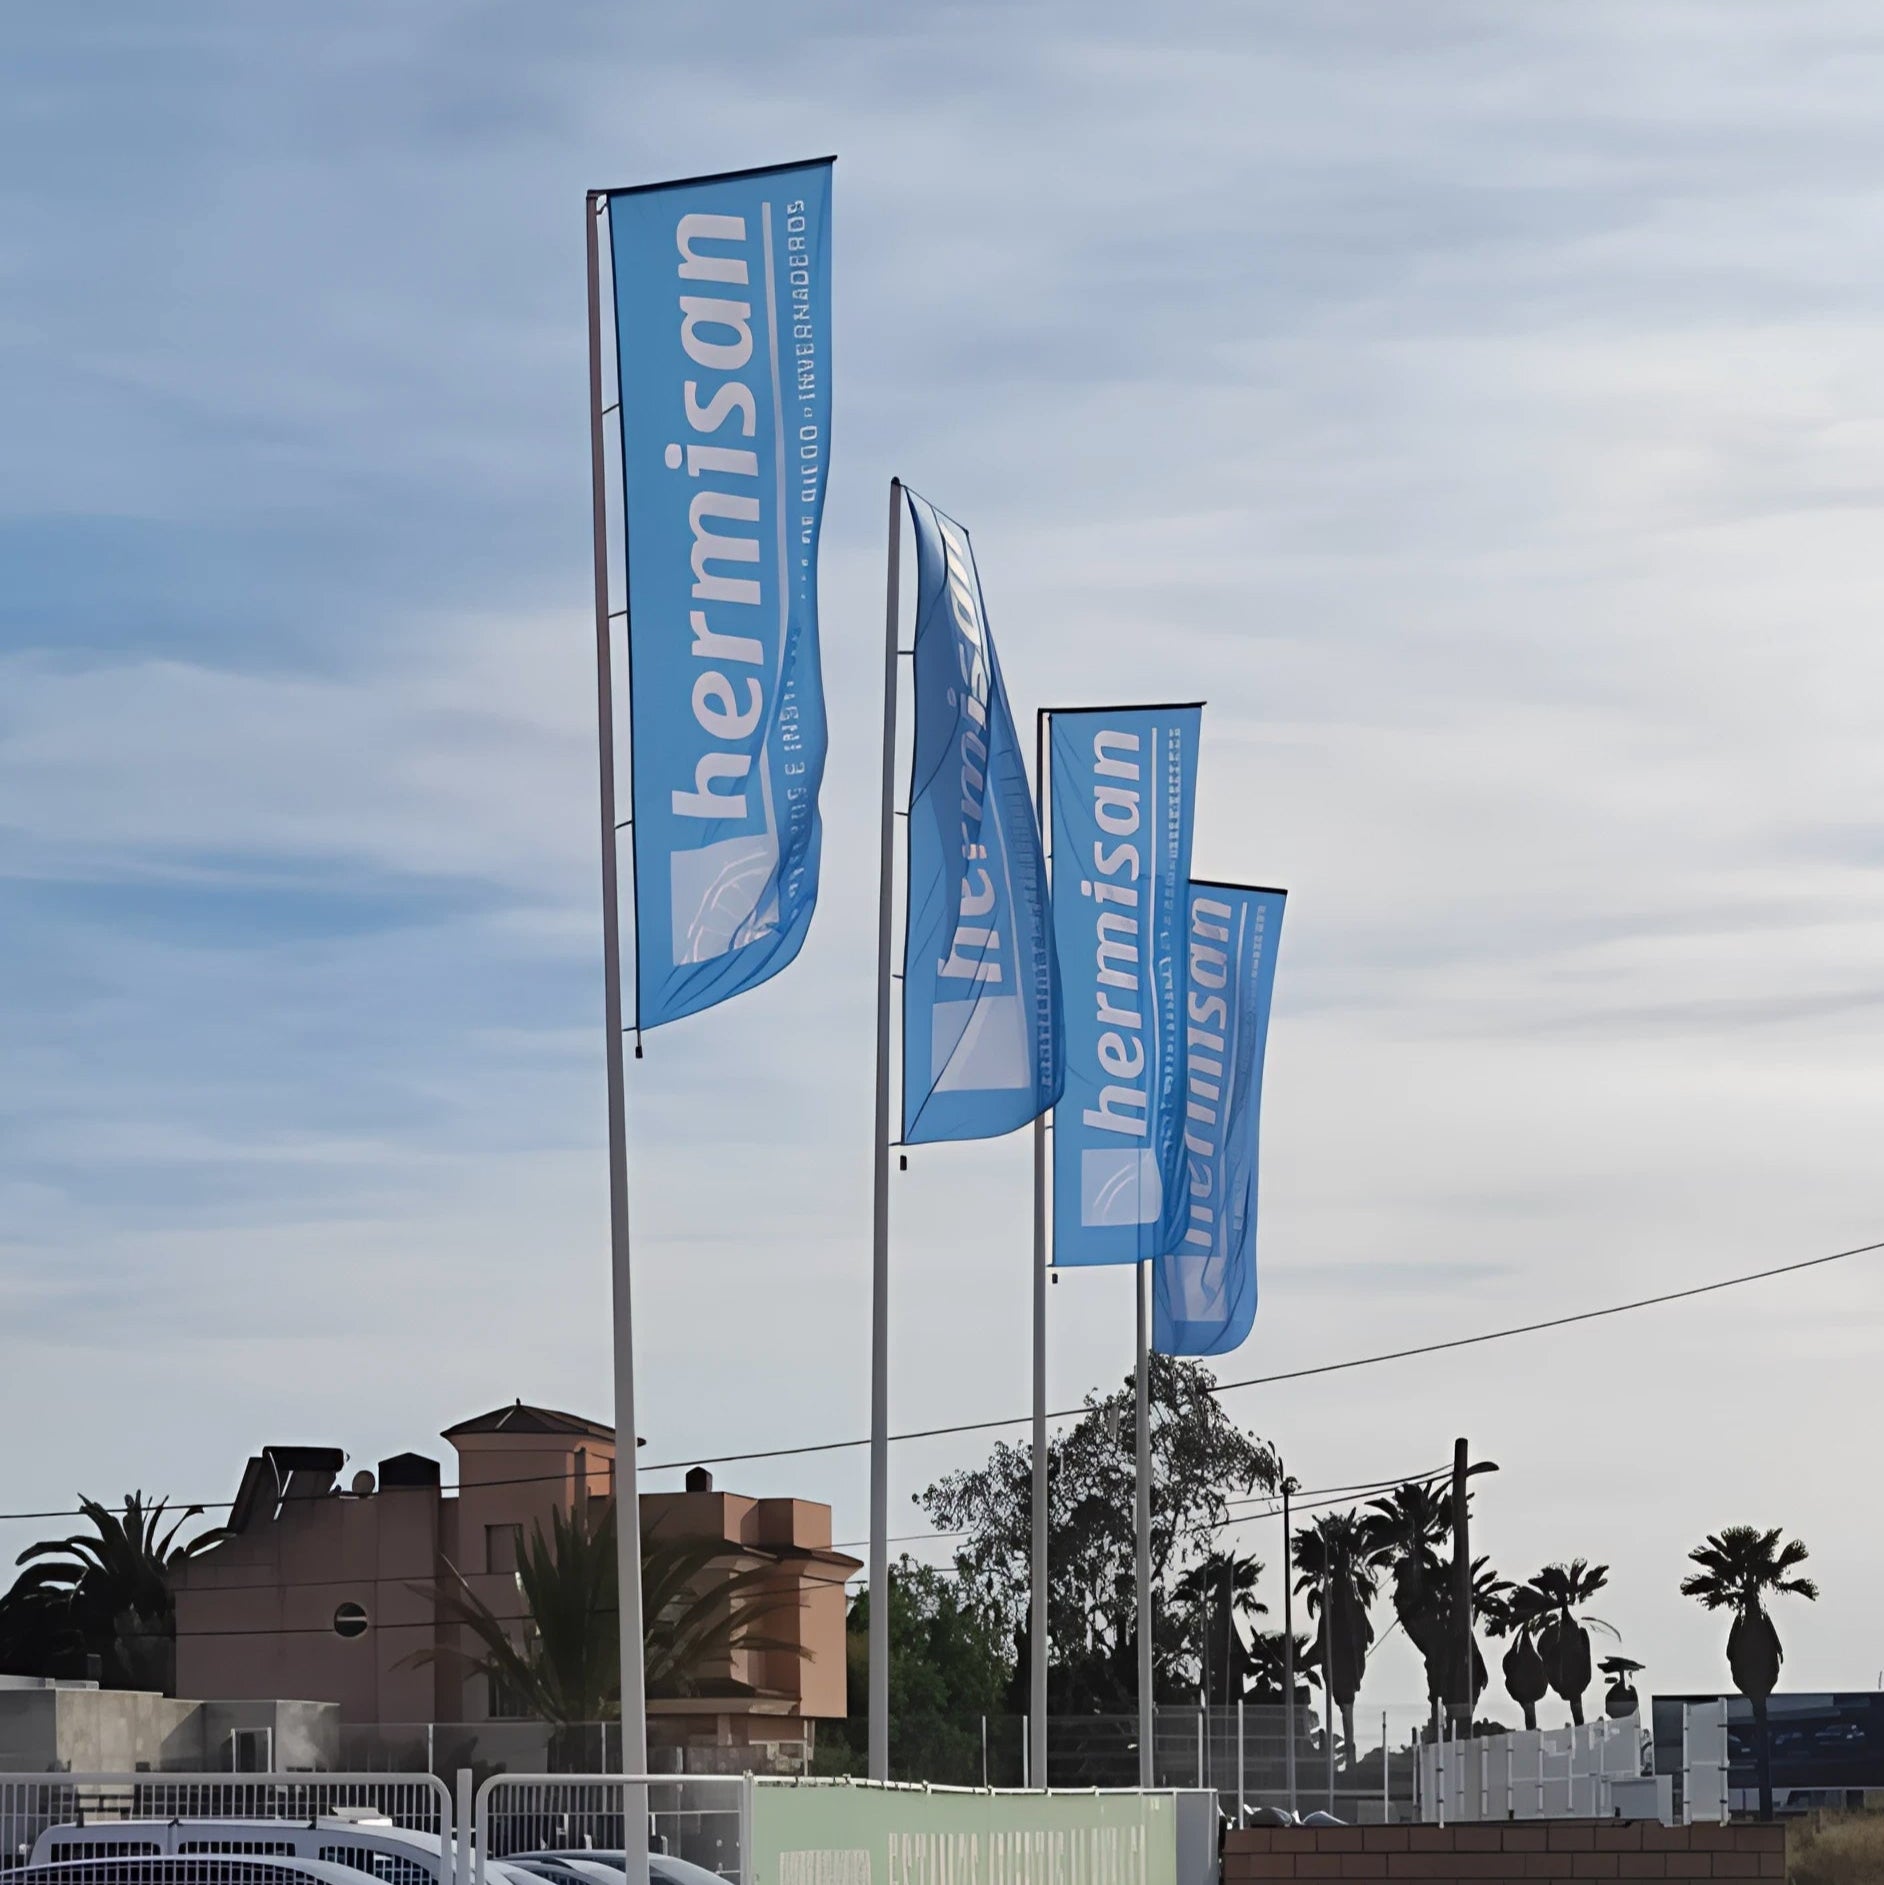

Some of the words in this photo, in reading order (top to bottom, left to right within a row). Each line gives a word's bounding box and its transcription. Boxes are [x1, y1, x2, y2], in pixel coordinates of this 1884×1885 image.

[786, 199, 816, 400] INVERNADEROS
[665, 214, 763, 818] hermisan
[1081, 730, 1147, 1136] hermisan
